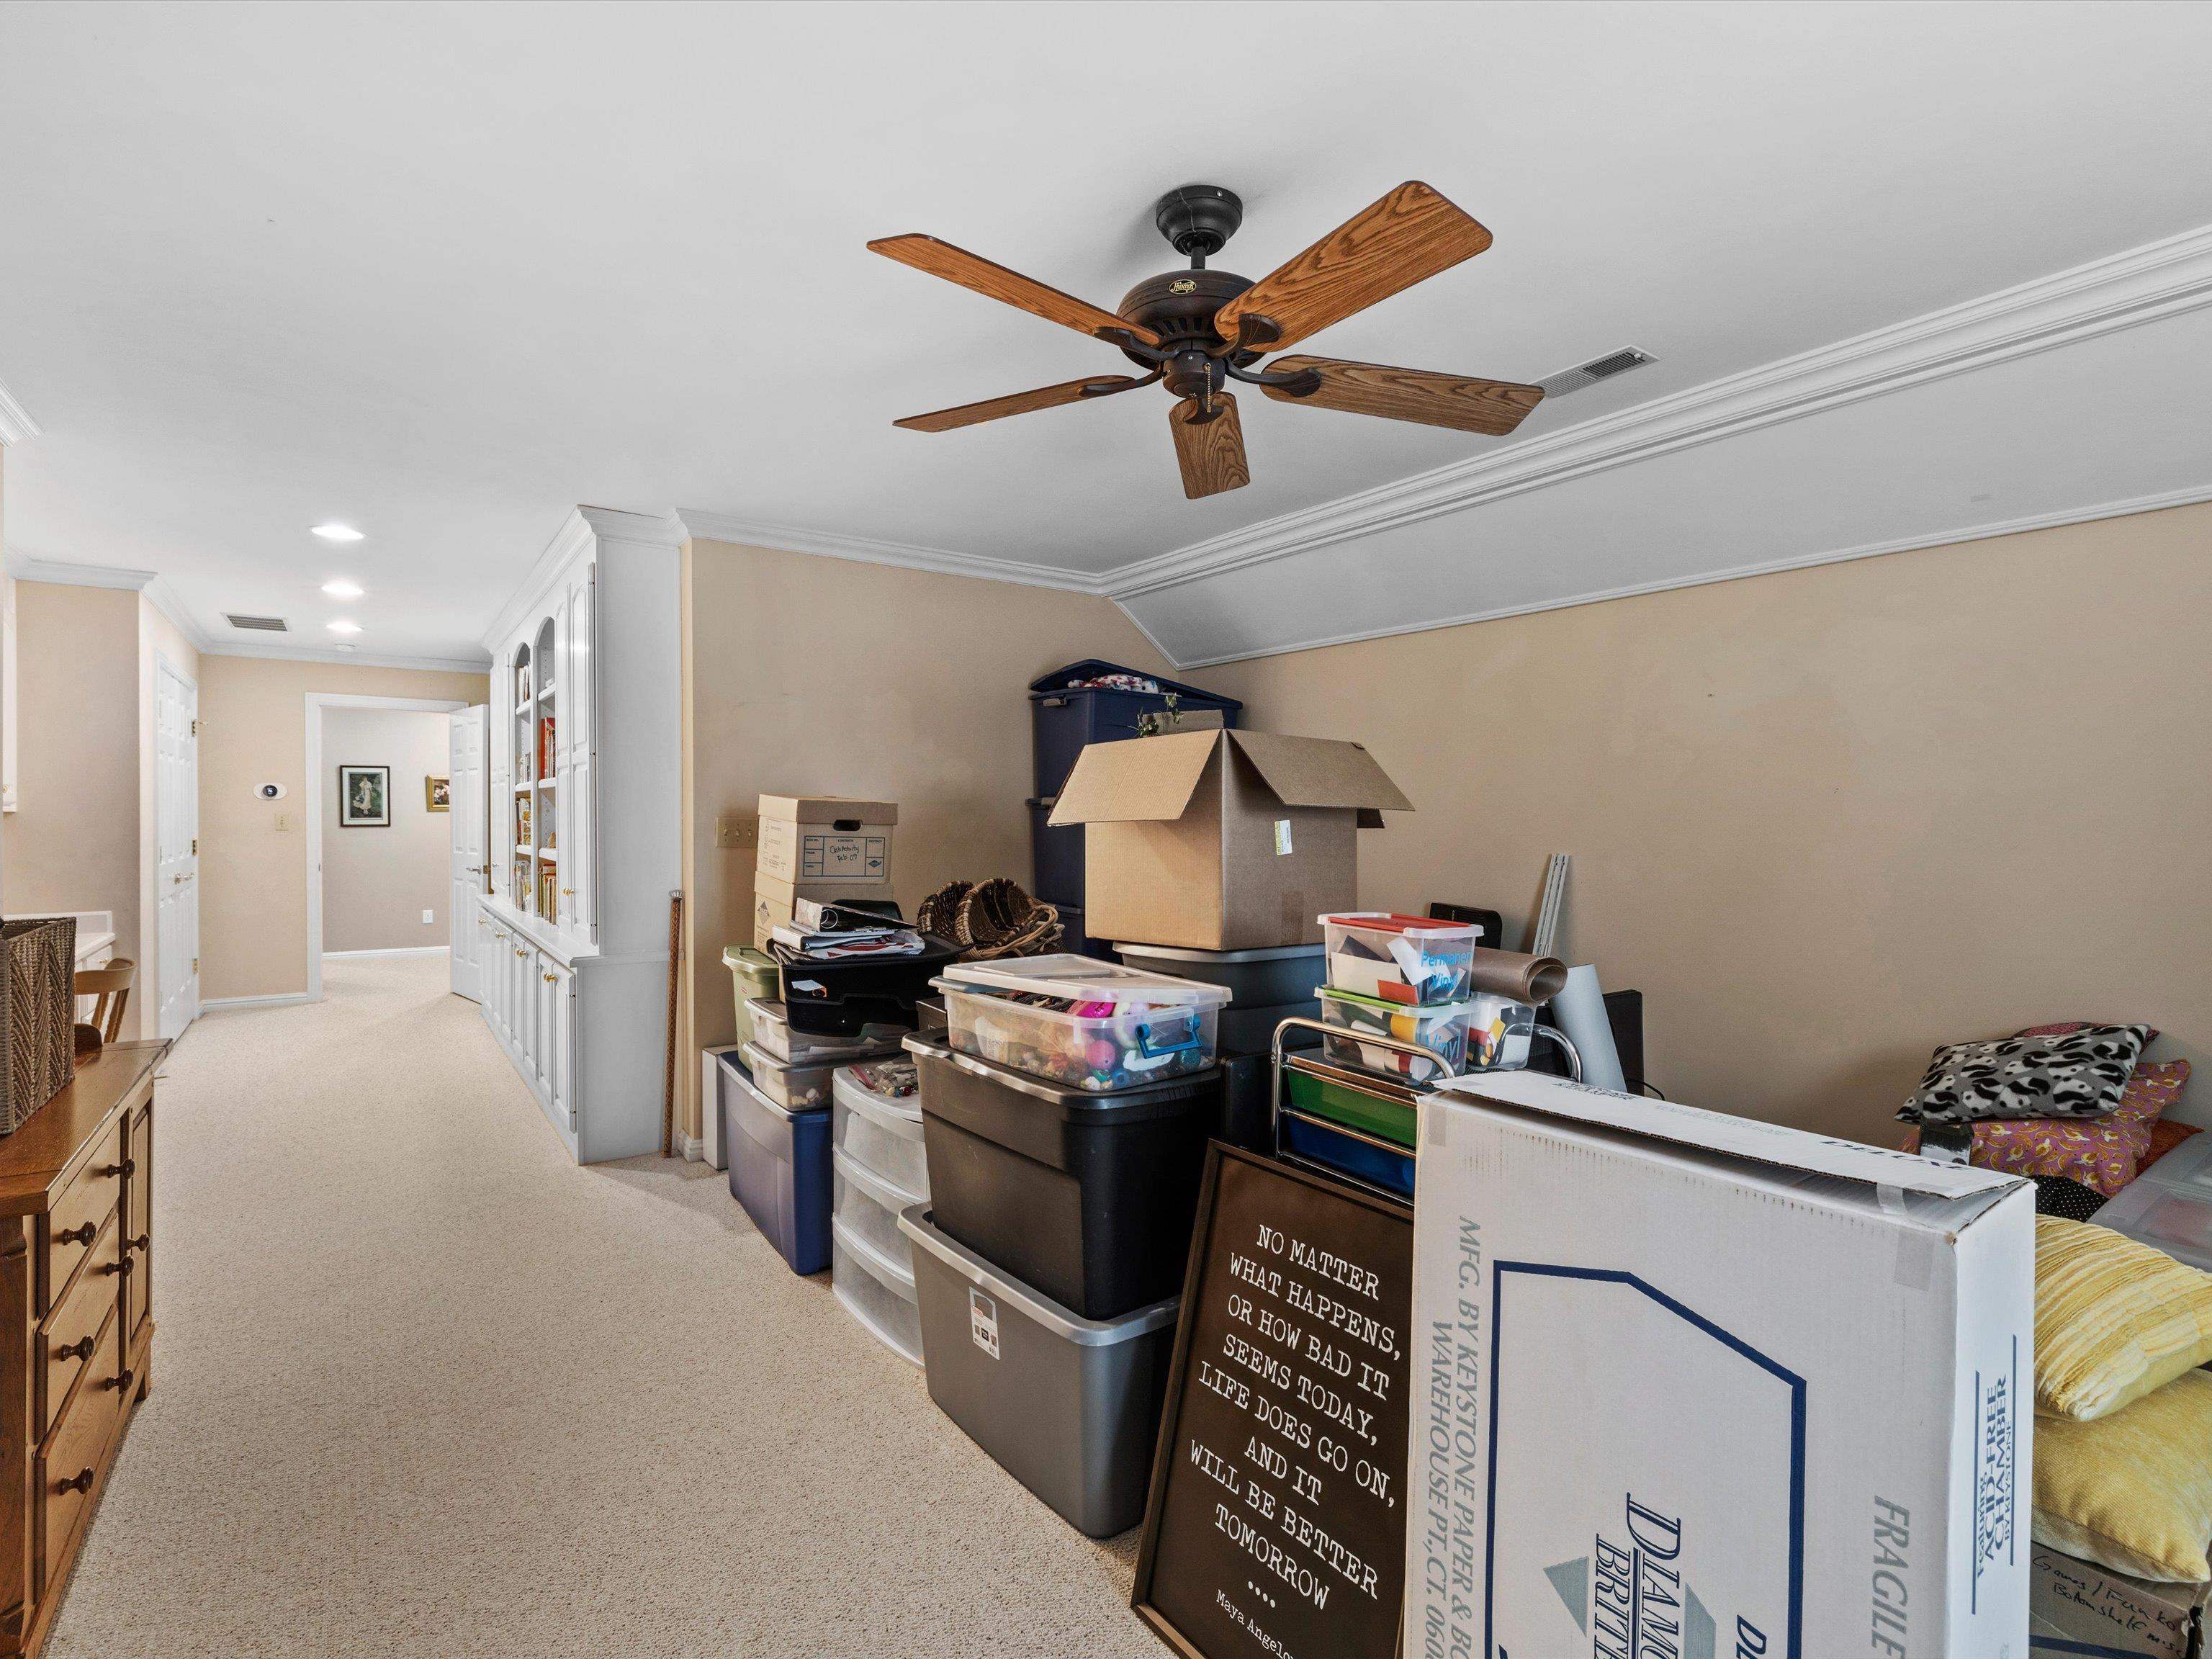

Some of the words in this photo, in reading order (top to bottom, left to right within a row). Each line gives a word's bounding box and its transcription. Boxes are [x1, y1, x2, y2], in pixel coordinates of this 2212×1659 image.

[1256, 1224, 1285, 1255] NO
[1289, 1238, 1379, 1301] MATTER
[1457, 1215, 1481, 1290] MFG.
[1228, 1294, 1253, 1326] OR
[1257, 1309, 1302, 1350] HOW
[1305, 1334, 1352, 1377] BAD
[1357, 1362, 1390, 1401] IT
[1231, 1252, 1282, 1298] WHAT
[1286, 1280, 1401, 1361] HAPPENS,
[1457, 1298, 1480, 1343] BY
[1198, 1360, 1250, 1410] LIFE
[1254, 1395, 1312, 1449] DOES
[1317, 1436, 1348, 1472] GO
[1355, 1460, 1395, 1508] ON,
[1223, 1334, 1292, 1390] SEEMS
[1297, 1375, 1377, 1446] TODAY,
[1429, 1320, 1453, 1511] WAREHOUSE
[1455, 1341, 1479, 1502] KEYSTONE
[1244, 1436, 1287, 1479] AND
[1292, 1465, 1322, 1506] IT
[1986, 1385, 1997, 1561] ACID-FREE
[1995, 1374, 2006, 1550] CHAMBER
[1191, 1439, 1239, 1495] WILL
[1244, 1480, 1276, 1520] BE
[1280, 1506, 1378, 1600] BETTER
[1215, 1503, 1330, 1610] TOMORROW
[1452, 1499, 1475, 1593] PAPER
[1978, 1471, 1988, 1579] Featuring
[2005, 1518, 2010, 1541] BY
[2032, 1555, 2086, 1591] Games
[1216, 1588, 1245, 1625] Maya
[1246, 1618, 1293, 1659] Angelo
[1451, 1593, 1473, 1620] &
[1871, 1495, 1910, 1659] FRAGILE
[1425, 1604, 1446, 1659] 060
